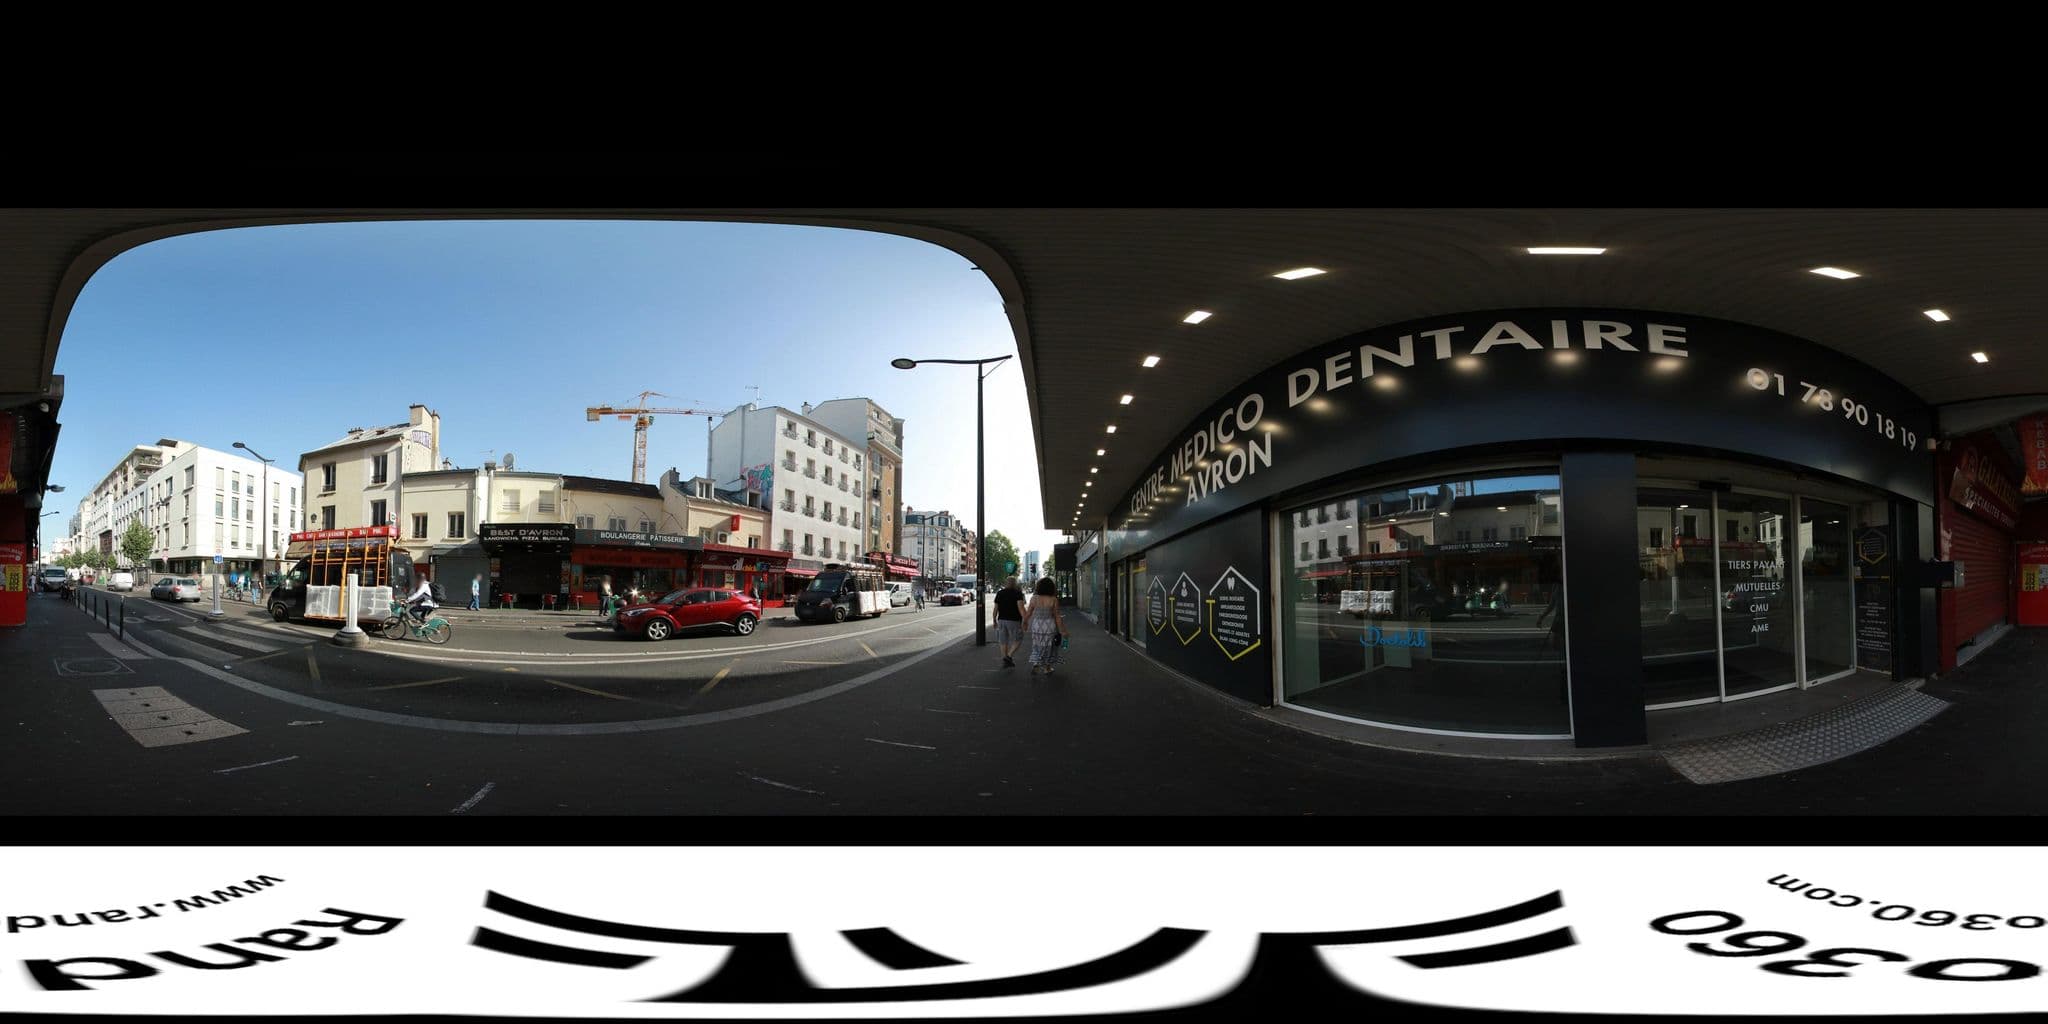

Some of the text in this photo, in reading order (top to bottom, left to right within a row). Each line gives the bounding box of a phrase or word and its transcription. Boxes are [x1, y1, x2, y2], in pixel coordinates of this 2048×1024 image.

[1746, 367, 1917, 451] 01 78 90 18 19
[1131, 319, 1689, 515] CENTRE MEDICO DENTAIRE
[1186, 432, 1272, 508] AVRON
[600, 531, 646, 541] BOULANGERIE
[1727, 560, 1751, 570] TIERS
[1735, 581, 1781, 592] MUTUELLES
[1750, 603, 1769, 613] CMU
[1751, 623, 1769, 633] AME
